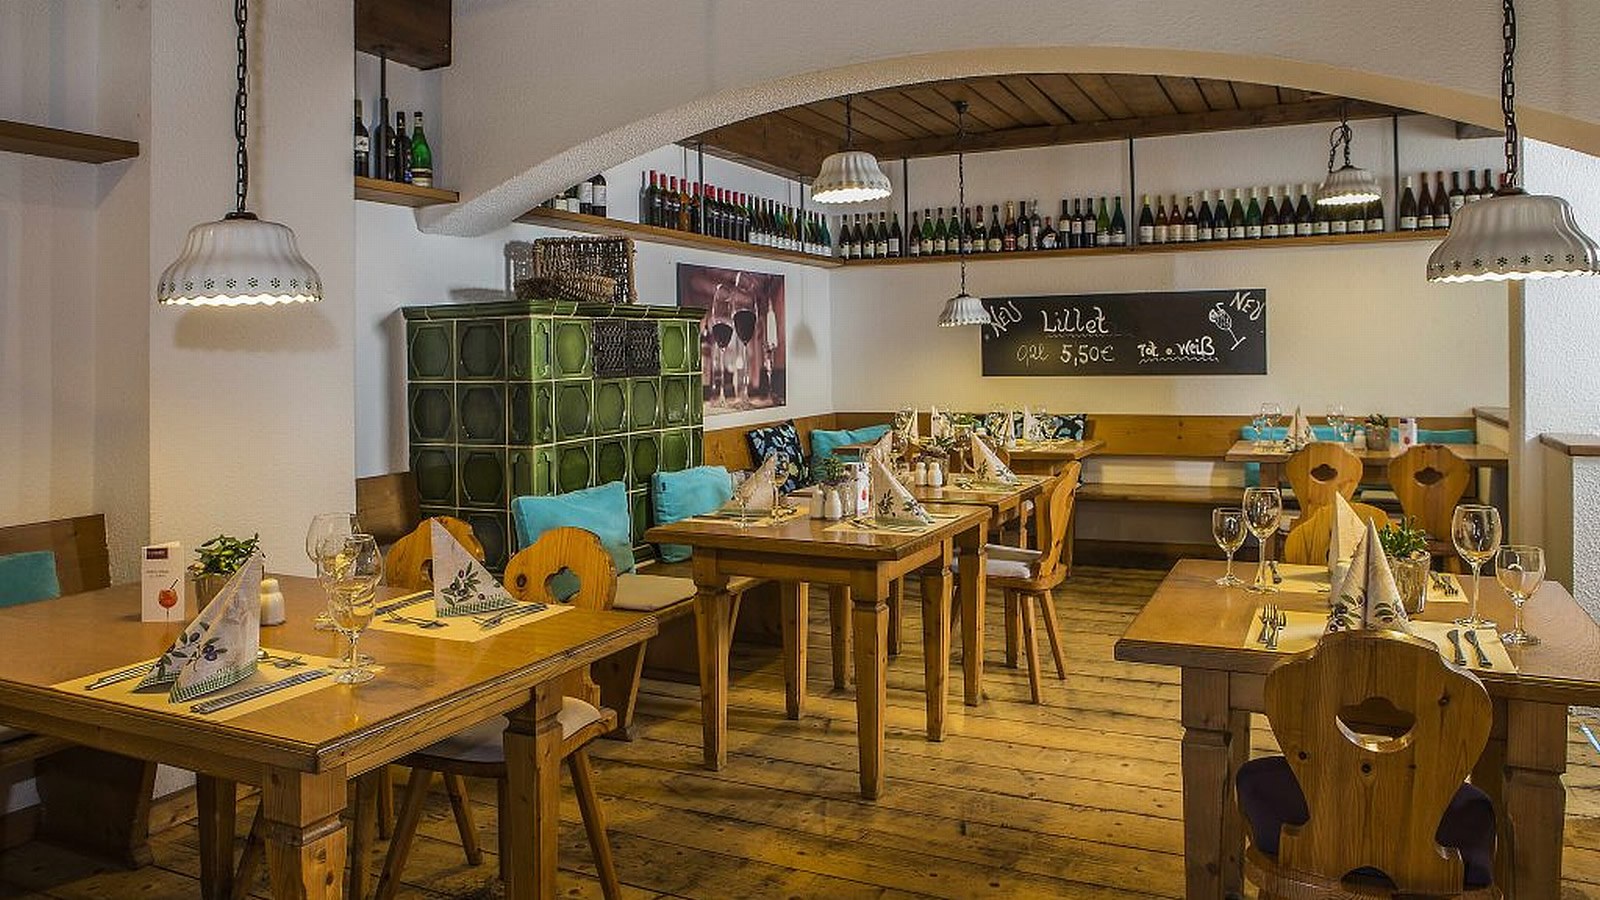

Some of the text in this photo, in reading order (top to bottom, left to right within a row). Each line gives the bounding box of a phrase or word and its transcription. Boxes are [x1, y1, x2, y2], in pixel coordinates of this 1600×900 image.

[990, 300, 1022, 338] NEU
[1040, 306, 1109, 334] Lillet
[1060, 343, 1115, 367] 5,50€
[1175, 335, 1216, 357] Weiß
